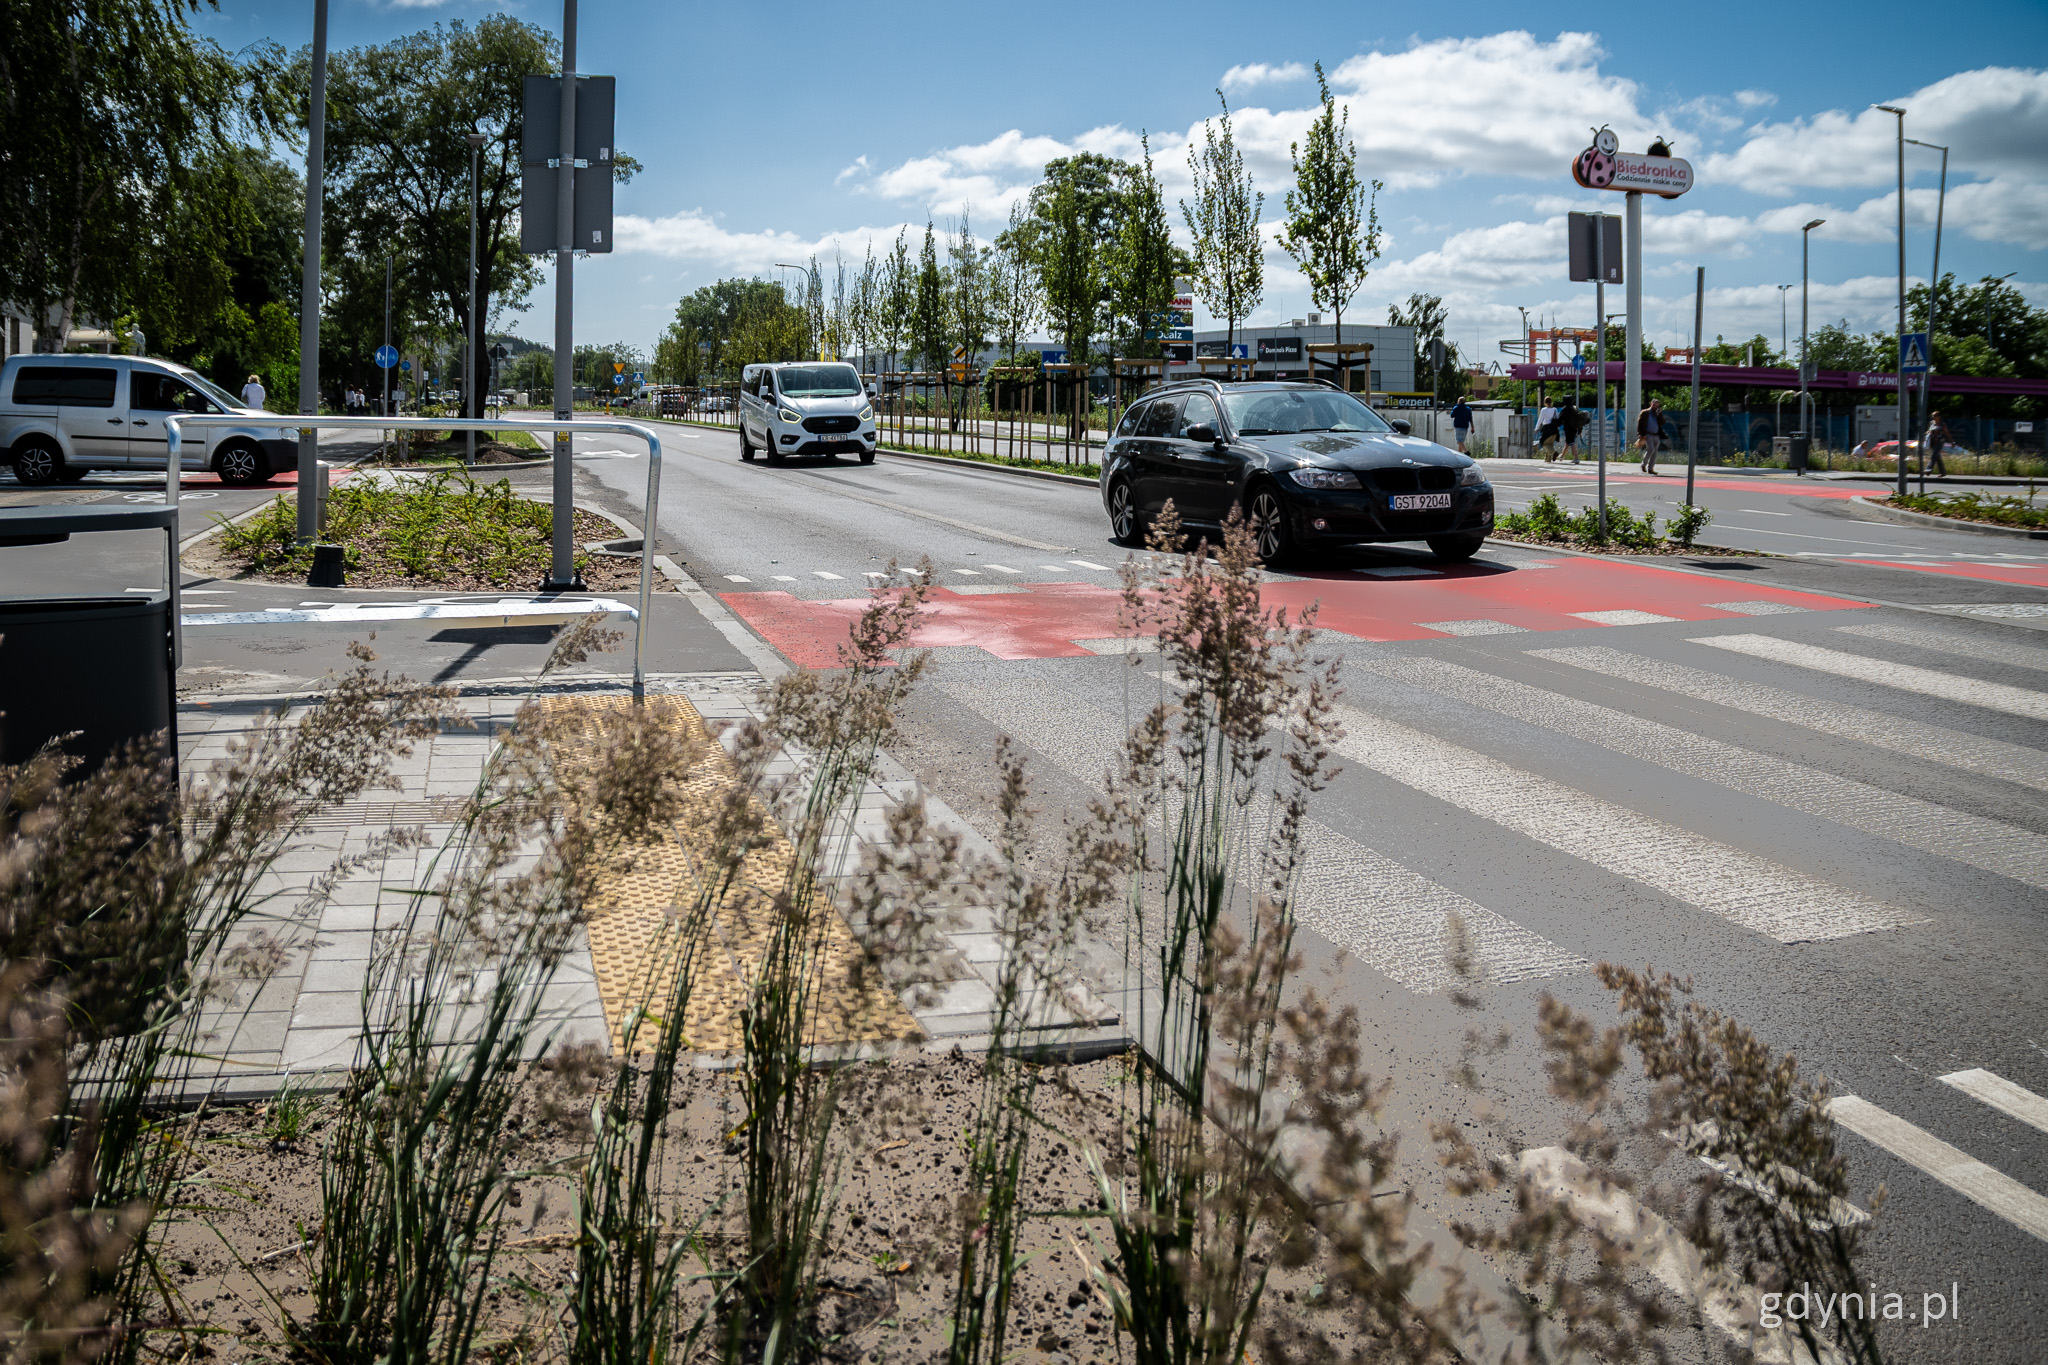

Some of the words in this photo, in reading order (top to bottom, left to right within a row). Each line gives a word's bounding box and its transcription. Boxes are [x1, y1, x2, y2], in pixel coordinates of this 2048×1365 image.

[1617, 159, 1687, 180] Biedronka
[1672, 180, 1686, 188] ceny
[1869, 377, 1899, 385] MYJNI
[1386, 396, 1430, 406] diaexpert
[1395, 496, 1416, 509] GST
[1419, 494, 1450, 508] 9204A
